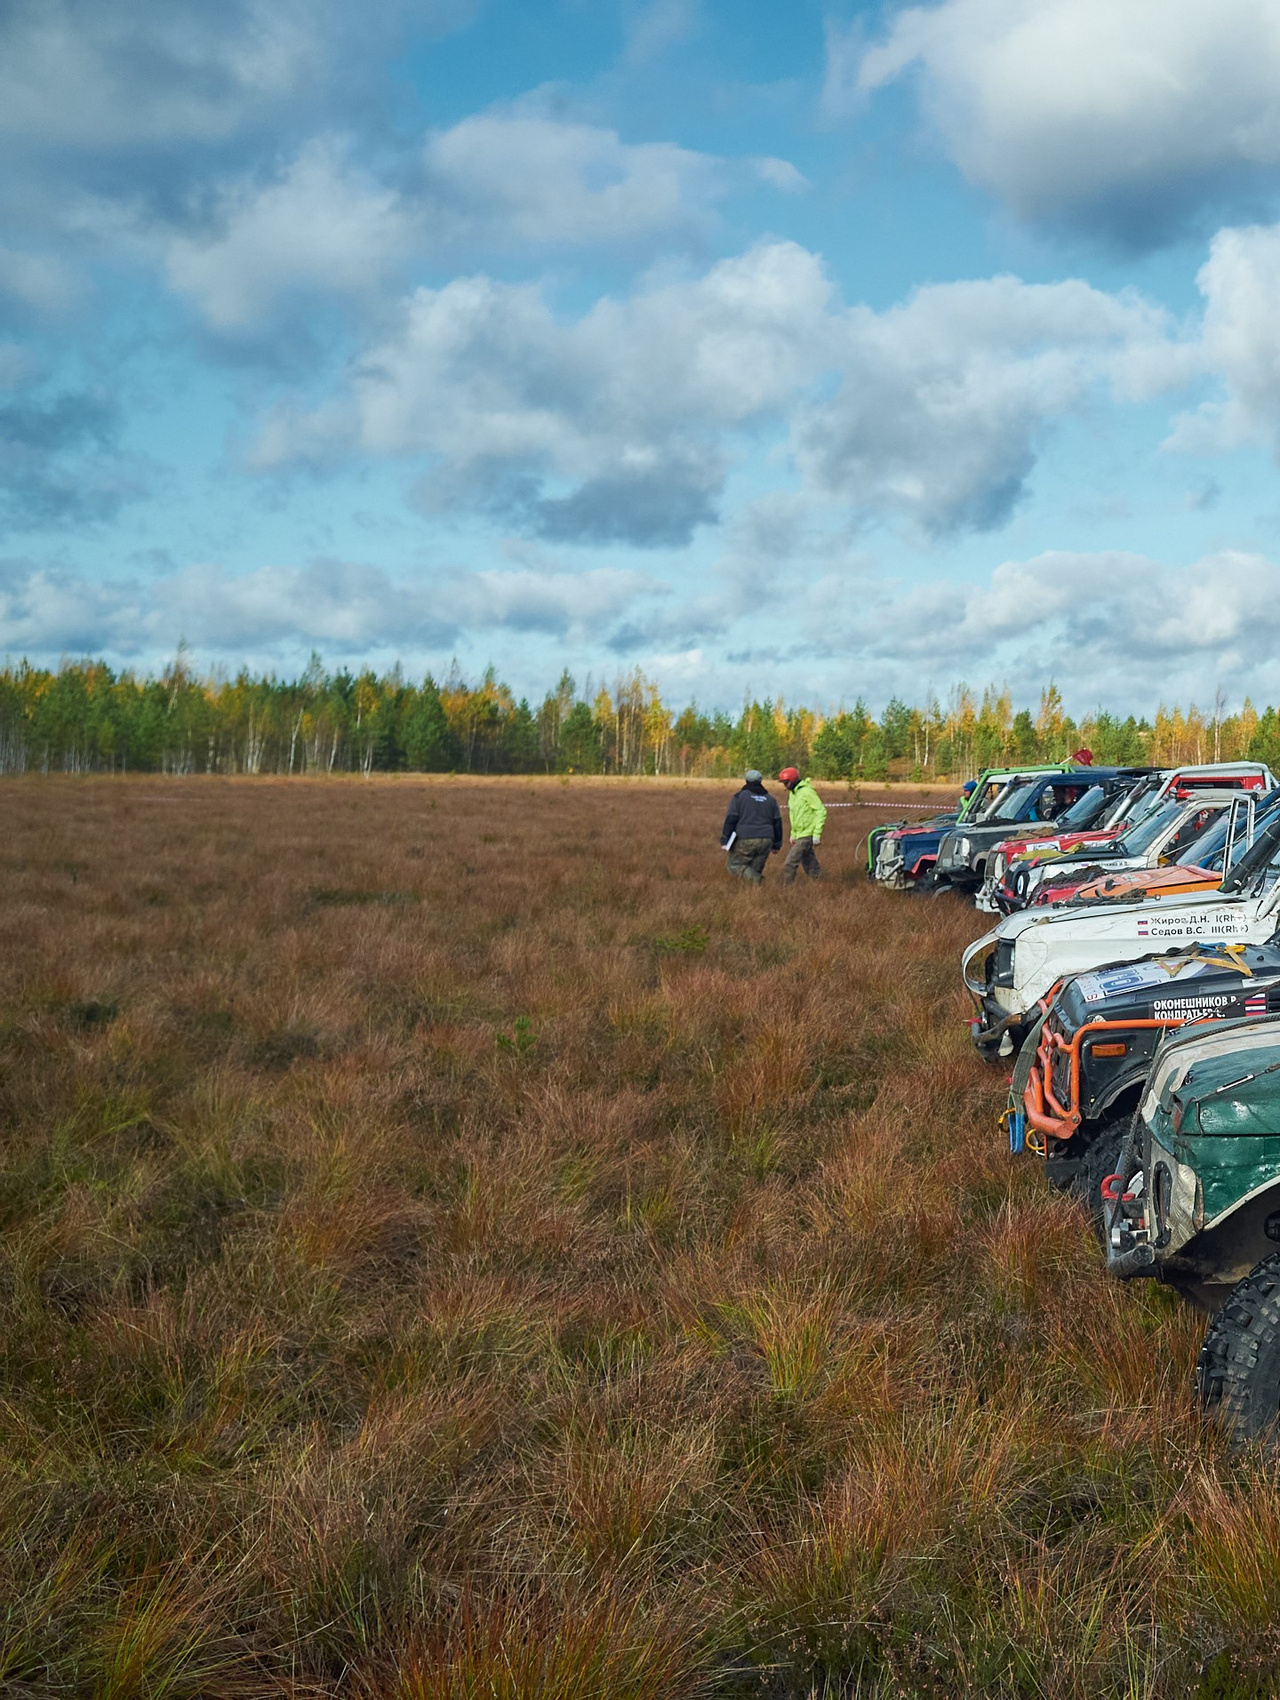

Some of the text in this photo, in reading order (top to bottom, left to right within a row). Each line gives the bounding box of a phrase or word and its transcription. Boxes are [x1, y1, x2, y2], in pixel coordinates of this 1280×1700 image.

[1151, 926, 1183, 936] Седов
[1186, 926, 1206, 935] В.С.
[1153, 997, 1228, 1011] ОКОНЕШНИКОВ
